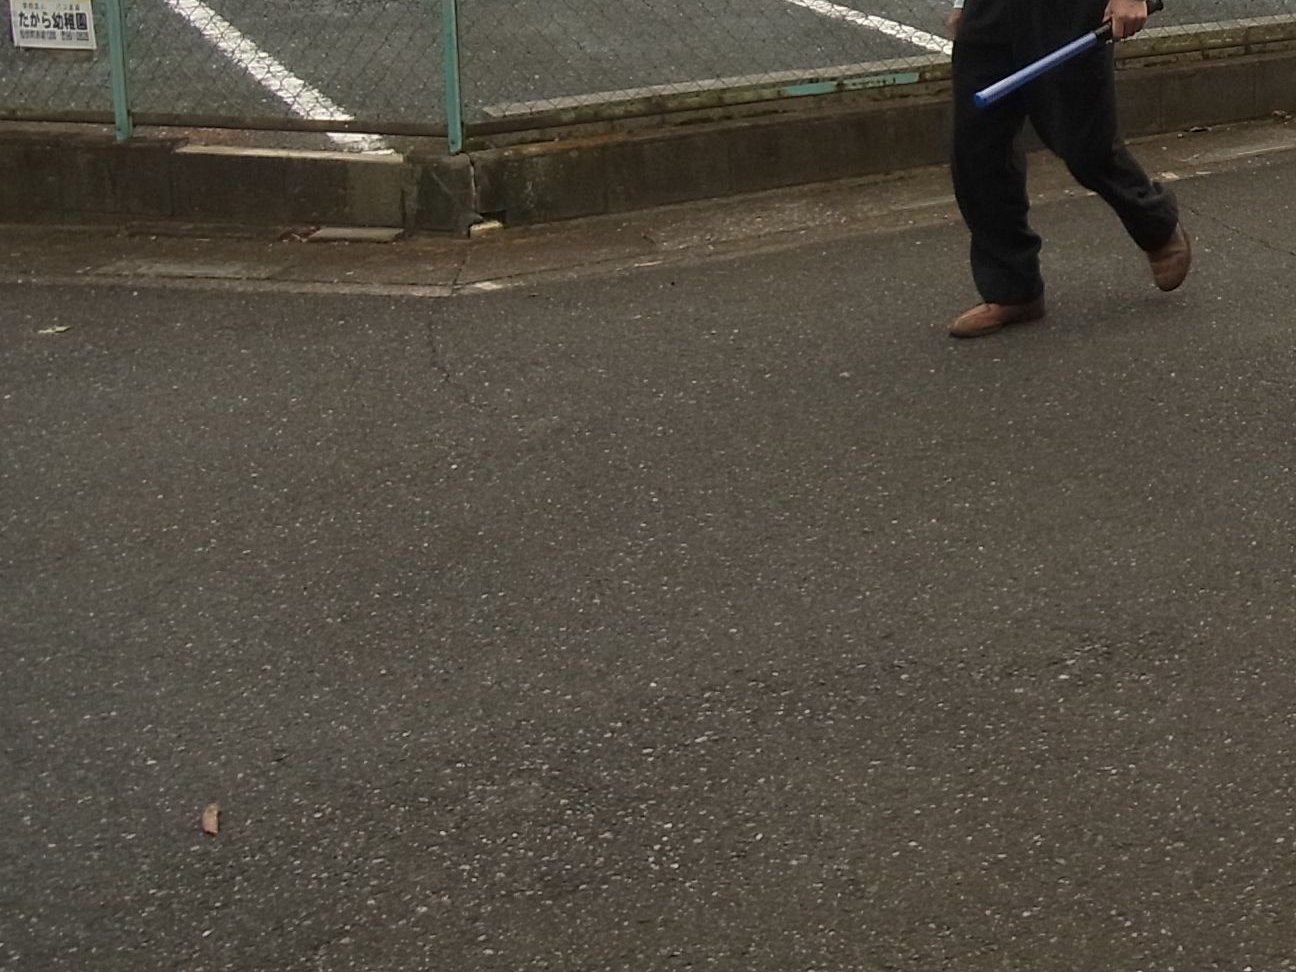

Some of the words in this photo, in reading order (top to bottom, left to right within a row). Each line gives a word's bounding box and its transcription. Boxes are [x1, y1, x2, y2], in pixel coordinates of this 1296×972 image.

[18, 11, 88, 31] たから幼稚園
